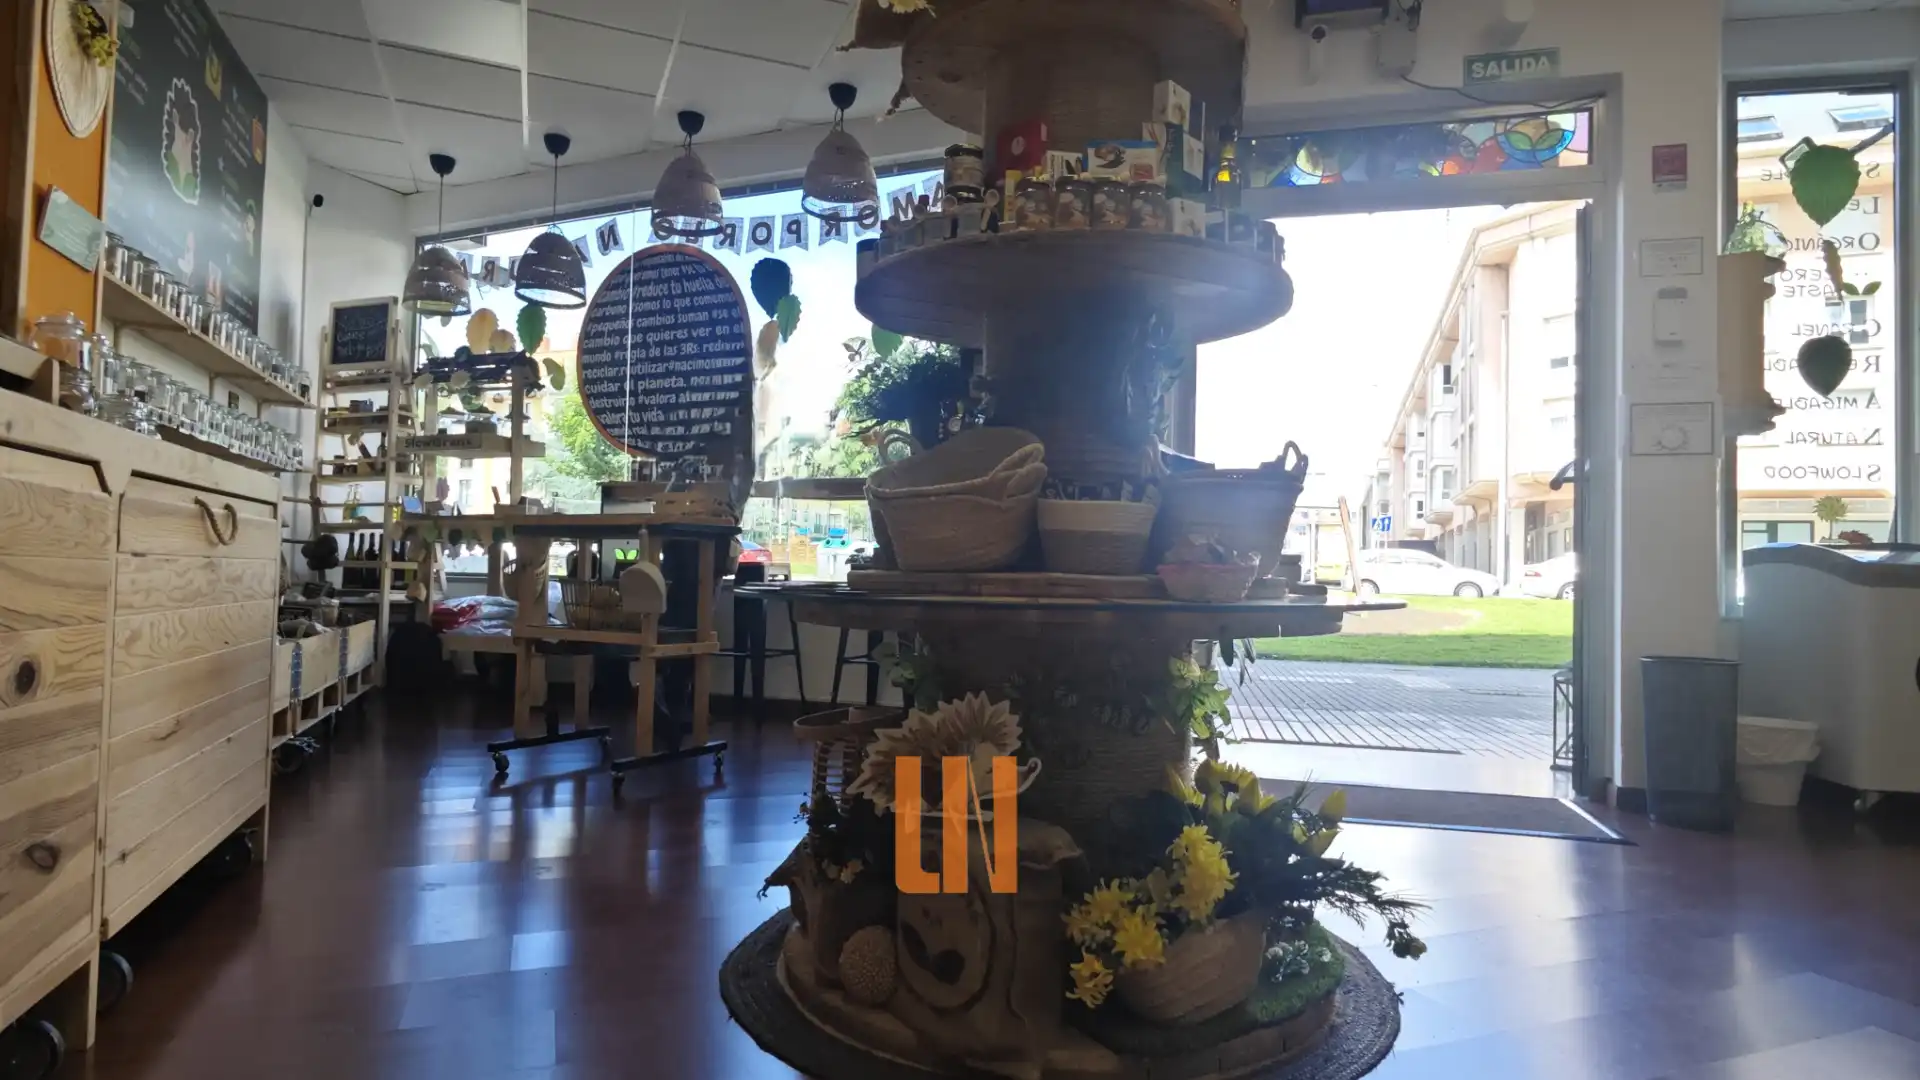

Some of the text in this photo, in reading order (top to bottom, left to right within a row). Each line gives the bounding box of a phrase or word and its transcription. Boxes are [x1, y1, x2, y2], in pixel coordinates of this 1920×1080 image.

[1471, 55, 1551, 78] SALIDA
[636, 313, 676, 328] cambios
[677, 312, 709, 323] suman
[646, 329, 689, 349] quieres
[691, 326, 713, 338] ver
[715, 324, 730, 336] en
[649, 346, 661, 358] de
[664, 344, 678, 356] las
[585, 381, 621, 394] cuidar
